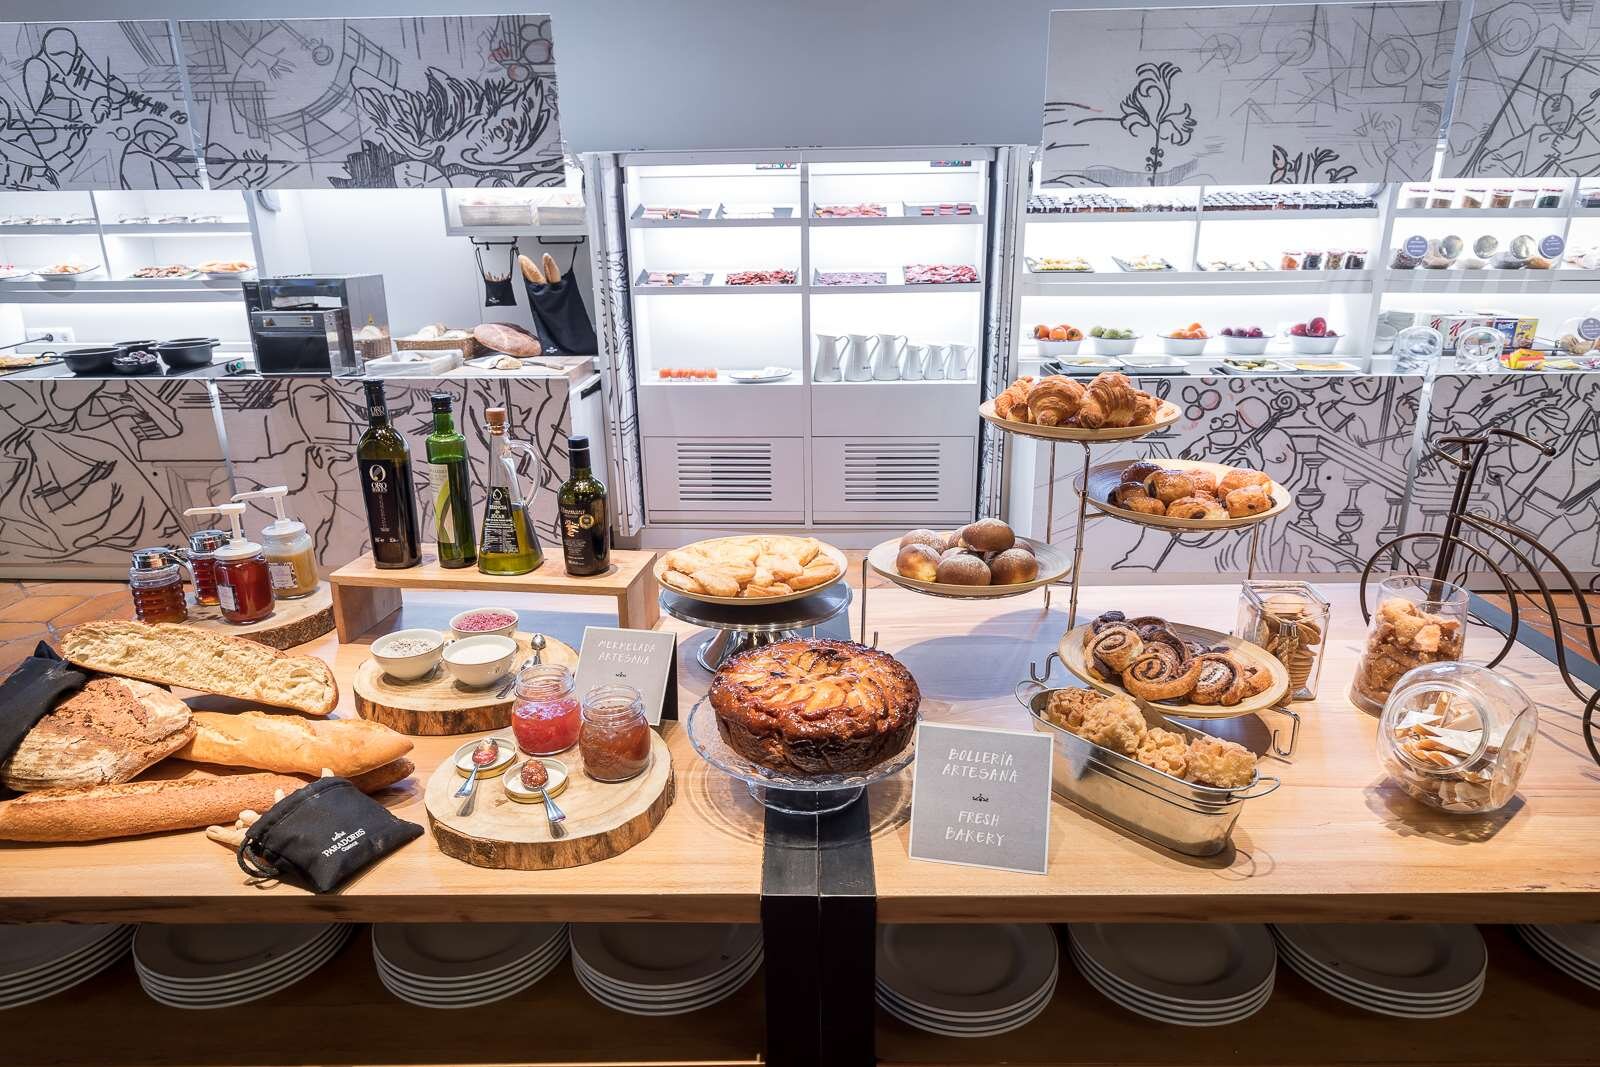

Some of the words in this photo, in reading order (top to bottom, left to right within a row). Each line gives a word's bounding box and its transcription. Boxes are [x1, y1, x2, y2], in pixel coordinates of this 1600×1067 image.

[598, 639, 656, 653] MERMELADA
[598, 651, 650, 665] ARTESANA
[948, 748, 1014, 766] BOLLERÍA
[942, 763, 1019, 783] ARTESANA
[958, 810, 1000, 827] FRESH
[321, 828, 366, 857] PARADORES
[945, 826, 1007, 847] BAKERY
